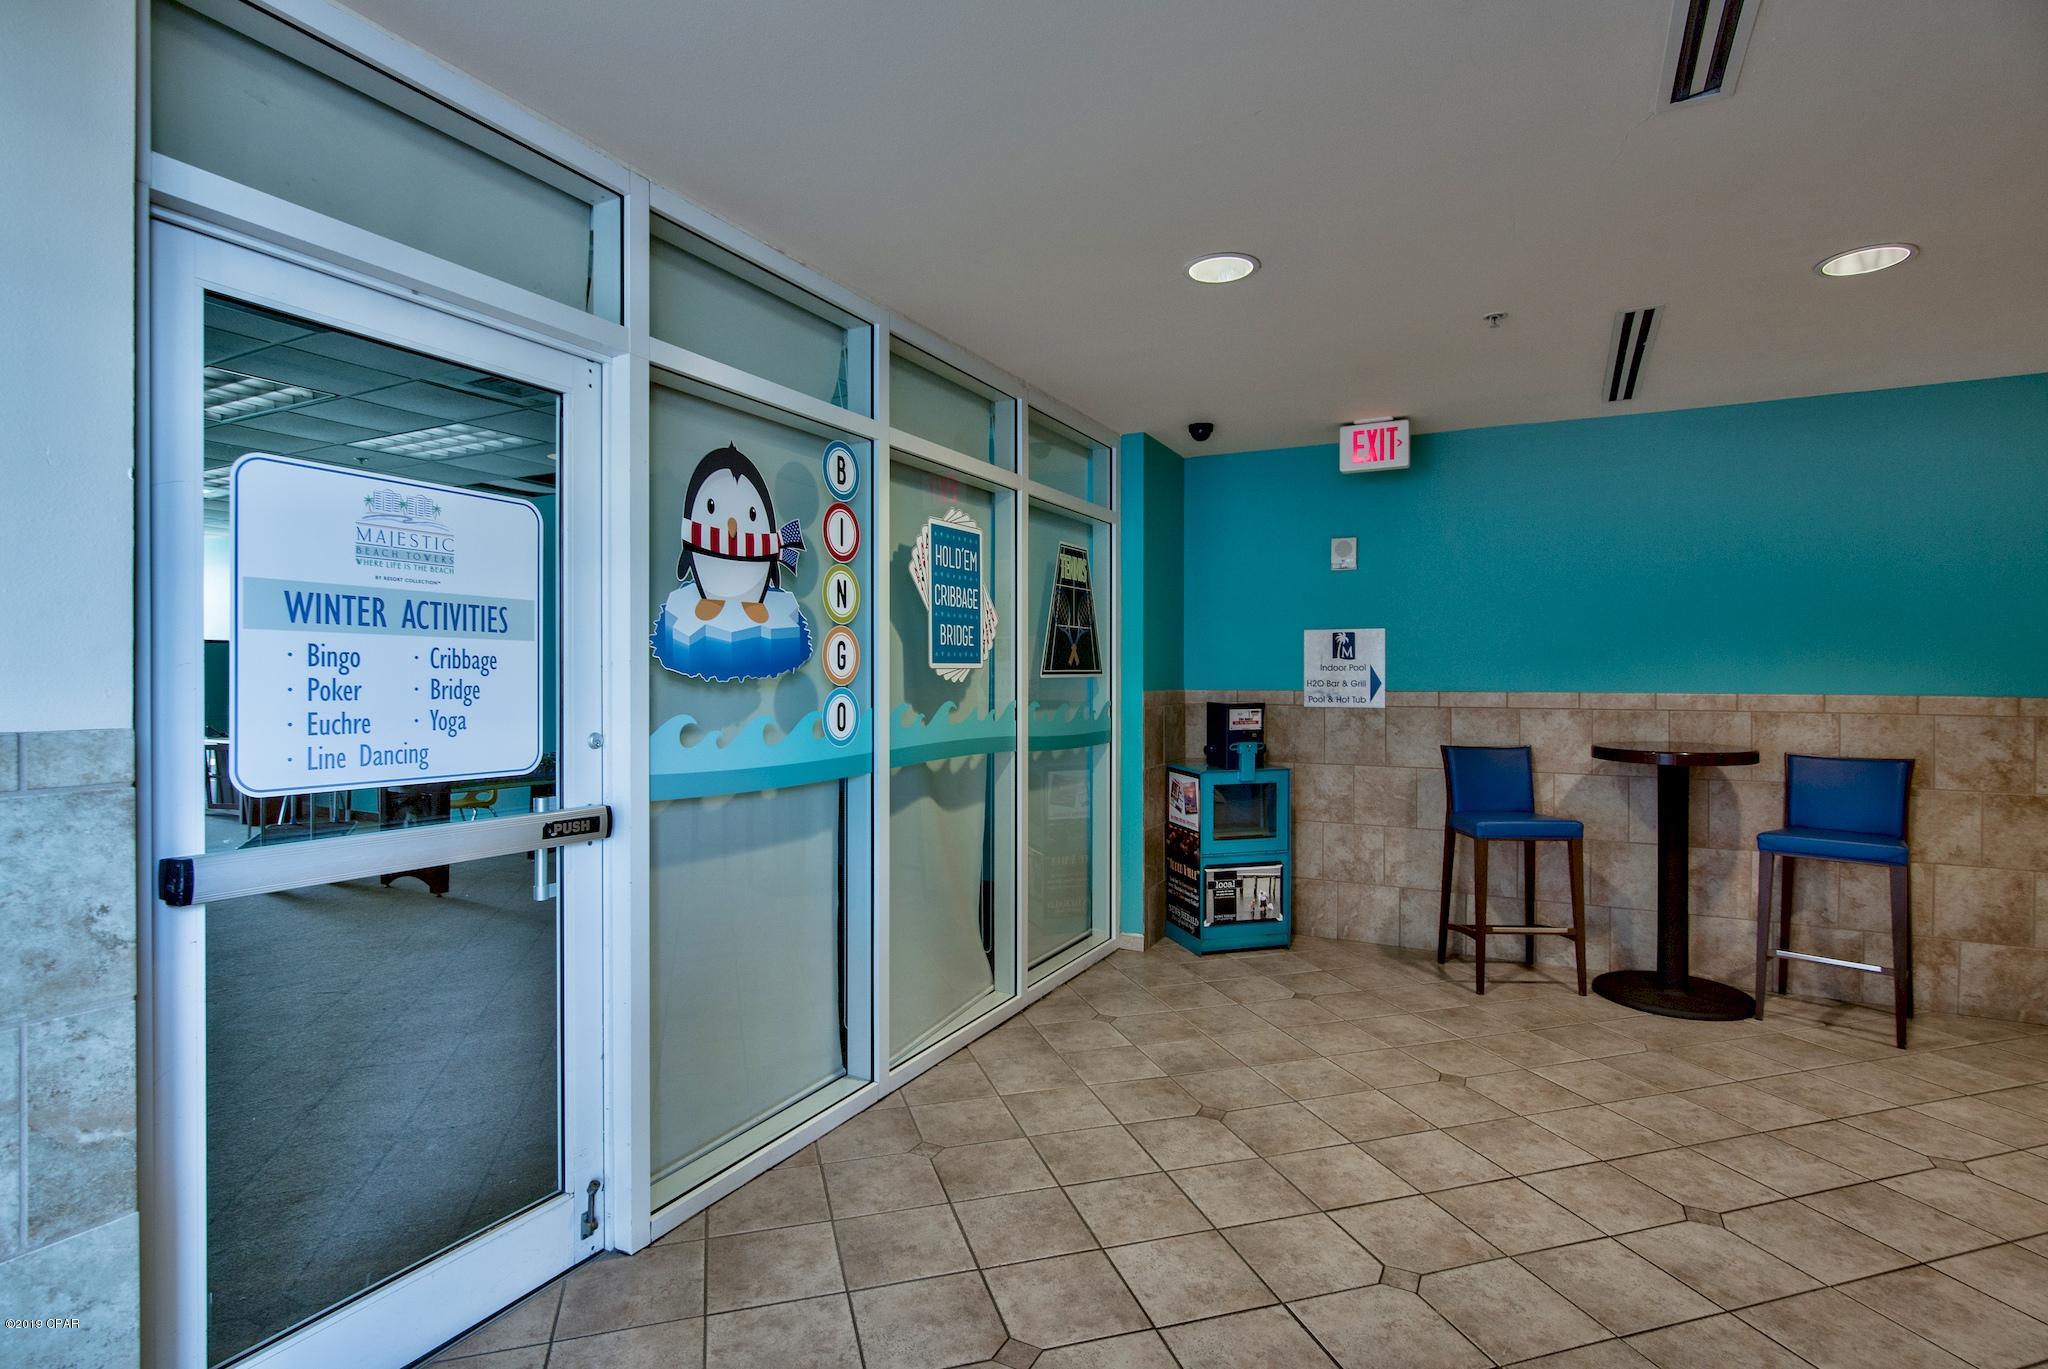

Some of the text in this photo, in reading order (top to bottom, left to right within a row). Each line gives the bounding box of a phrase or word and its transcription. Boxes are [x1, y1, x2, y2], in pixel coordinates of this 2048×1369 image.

[1352, 426, 1399, 464] EXIT
[355, 526, 455, 552] MAJESTIC
[355, 545, 455, 565] BEACH TOWERS
[355, 558, 455, 575] WHERE LIFE IS THE BEACH
[935, 543, 978, 573] HOLD'EM
[934, 583, 979, 610] CRIBBAGE
[283, 590, 509, 634] WINTER ACTIVITIES
[940, 624, 975, 647] BRIDGE
[307, 643, 361, 676] Bingo
[430, 647, 498, 677] Cribbage
[1341, 645, 1354, 658] M
[1320, 664, 1367, 672] Indoor Pool
[307, 678, 362, 702] Poker
[430, 678, 481, 707] Bridge
[1306, 679, 1367, 688] H2O Bar & Grill
[1308, 695, 1367, 703] Pool & Hot Tub
[307, 711, 372, 737] Euchre
[430, 709, 467, 739] Yoga
[307, 741, 430, 771] Line Dancing
[553, 820, 591, 834] PUSH
[1215, 880, 1236, 889] local
